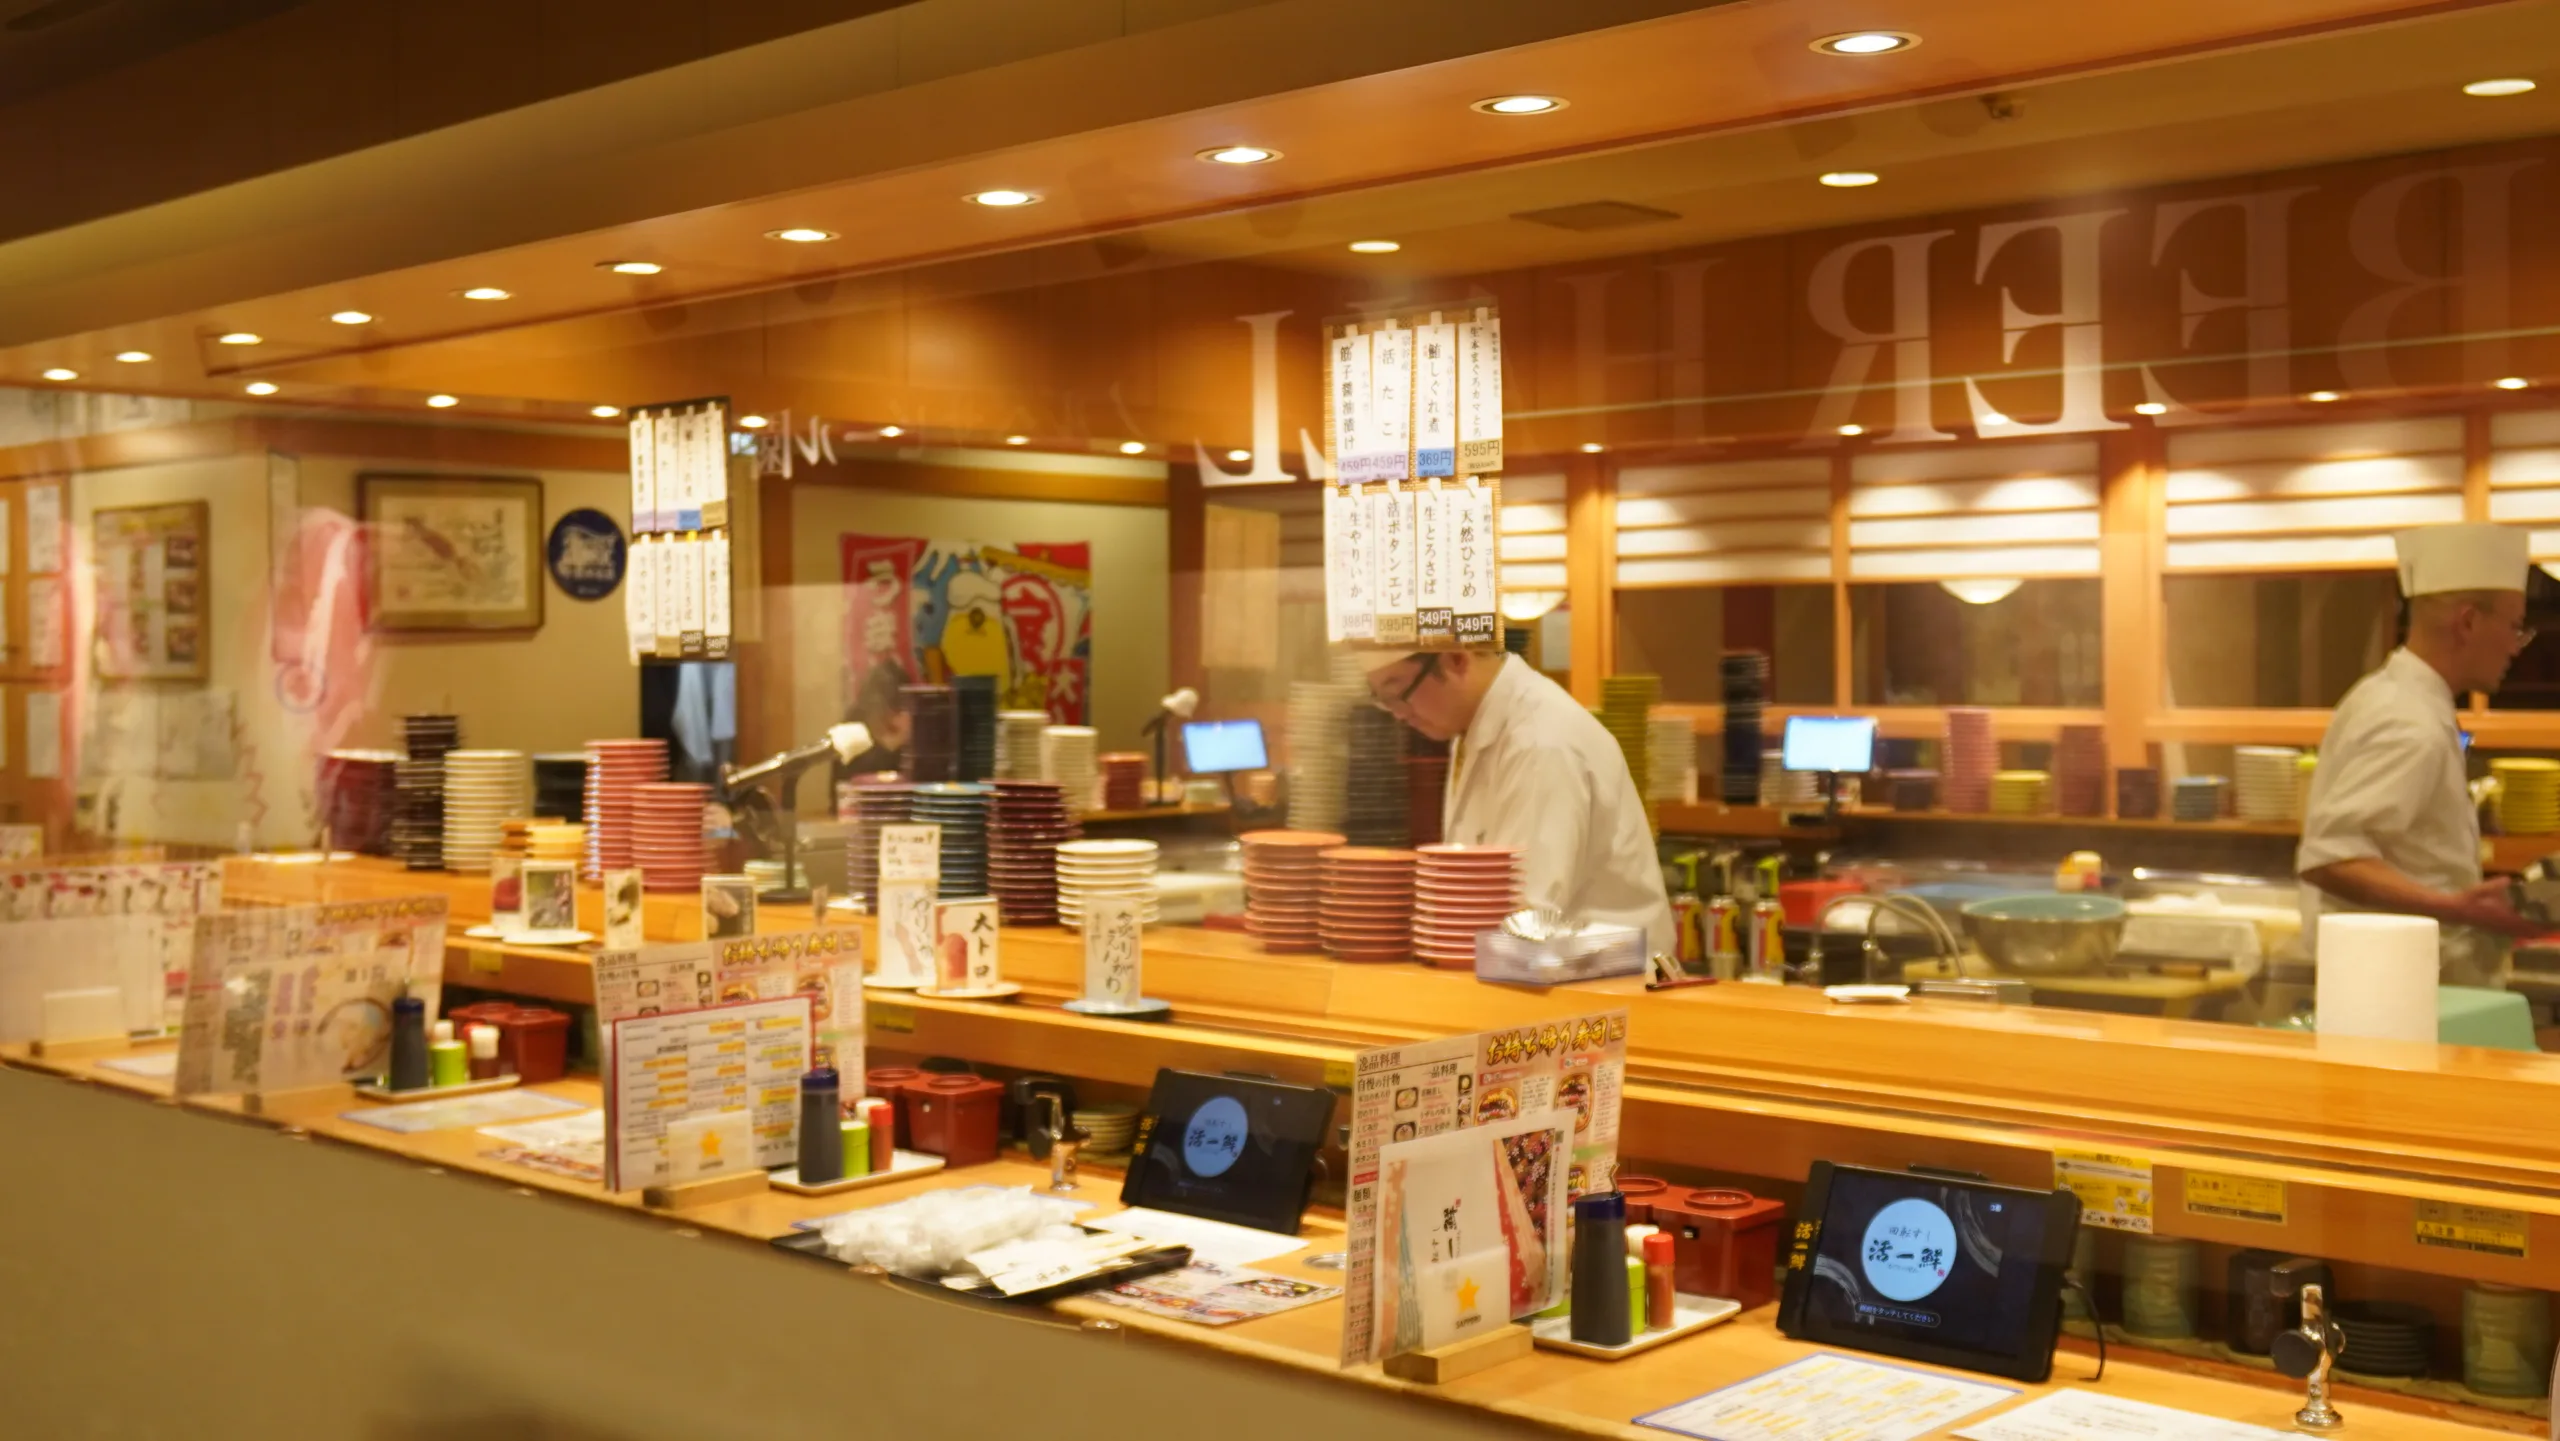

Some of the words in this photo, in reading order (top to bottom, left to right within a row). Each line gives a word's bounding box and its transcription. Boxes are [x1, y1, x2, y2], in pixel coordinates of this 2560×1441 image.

[1382, 348, 1396, 437] 活たこ
[1419, 450, 1452, 467] 369円
[1464, 440, 1500, 457] 595円
[1372, 454, 1406, 471] 459円
[1350, 512, 1363, 599] 生やりいか
[1387, 502, 1402, 608] 活ボタンエビ
[1424, 506, 1438, 595] 生とろさば
[1460, 509, 1476, 598] 天然ひらめ
[1418, 610, 1451, 626] 549円
[1457, 616, 1494, 632] 549円
[972, 912, 993, 978] 大トロ
[1486, 1016, 1608, 1066] お持ち帰り寿司
[1358, 1052, 1400, 1072] 逸品料理
[1357, 1073, 1400, 1092] 自慢の汁物
[1188, 1127, 1238, 1153] 活一鮮
[1868, 1239, 1943, 1271] 活一鮮
[1455, 1313, 1482, 1330] SAPPORO
